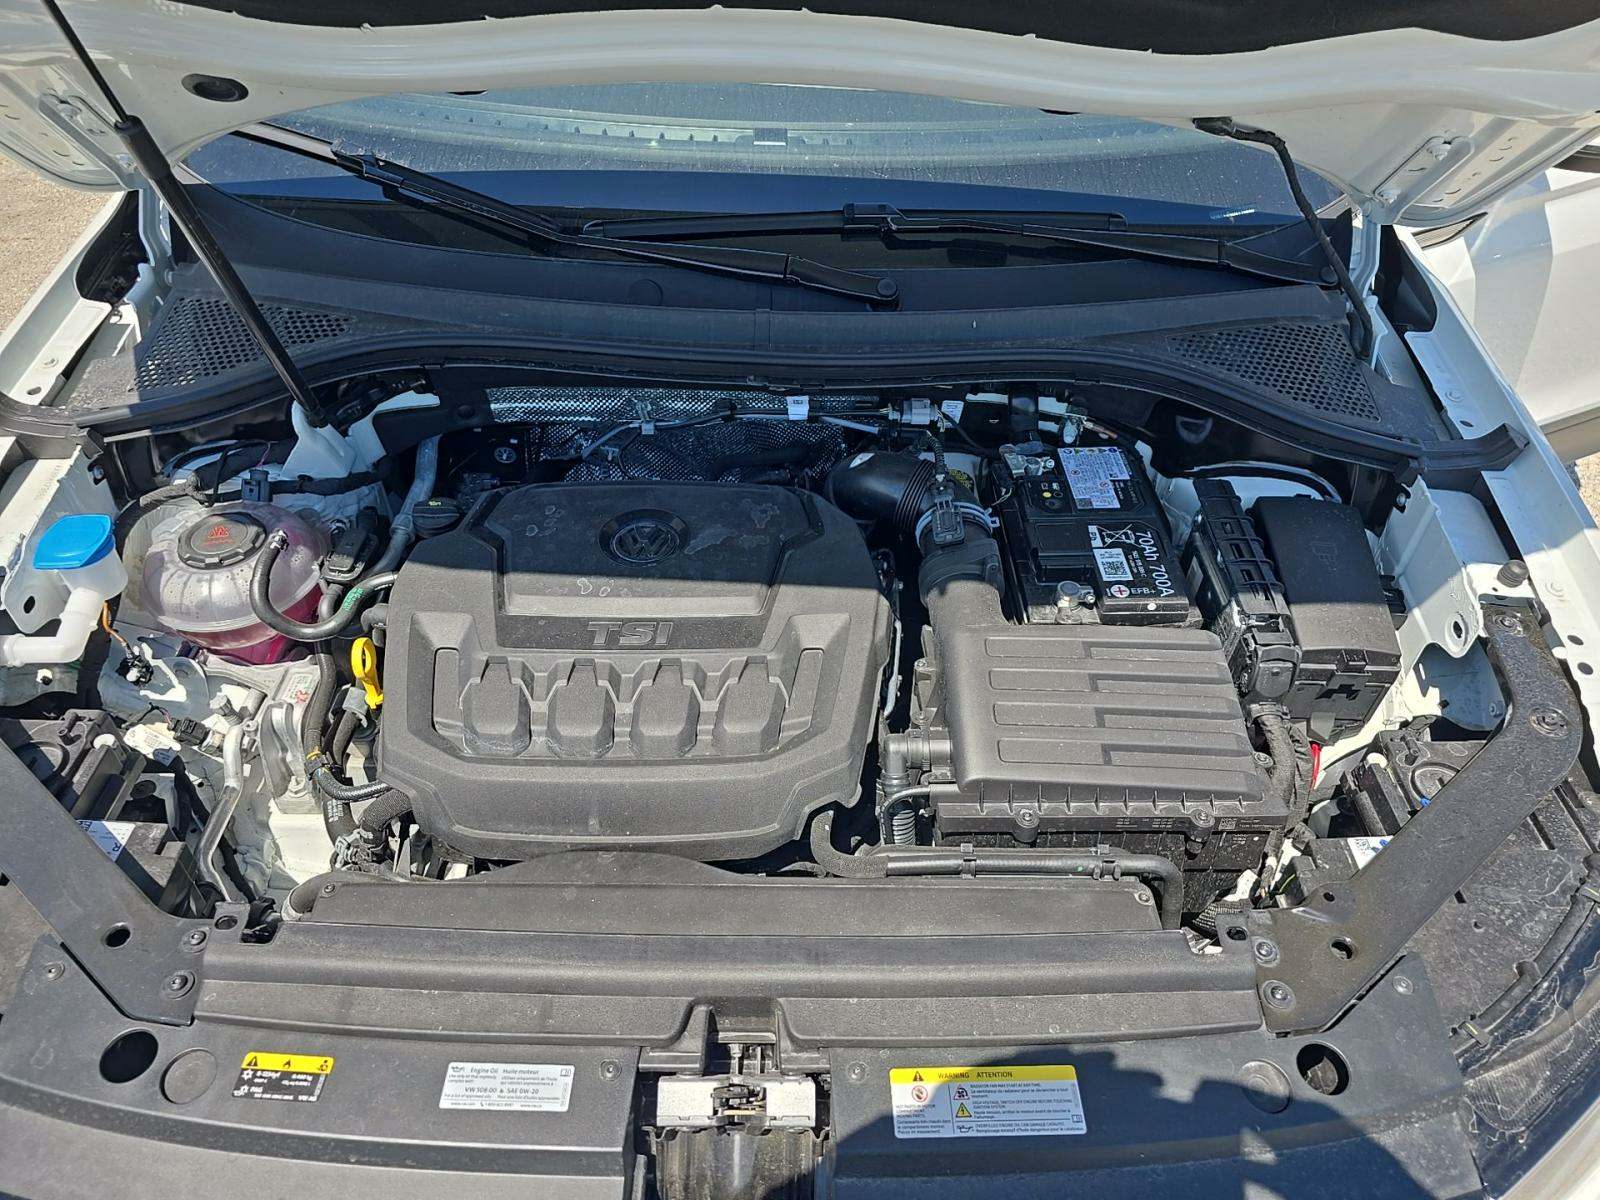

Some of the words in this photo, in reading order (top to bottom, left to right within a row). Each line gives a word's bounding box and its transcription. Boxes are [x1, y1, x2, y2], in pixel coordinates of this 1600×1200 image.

[1136, 530, 1158, 562] 70Ah
[1149, 564, 1175, 598] 700A
[587, 621, 674, 646] TSI
[470, 1067, 489, 1075] Engine
